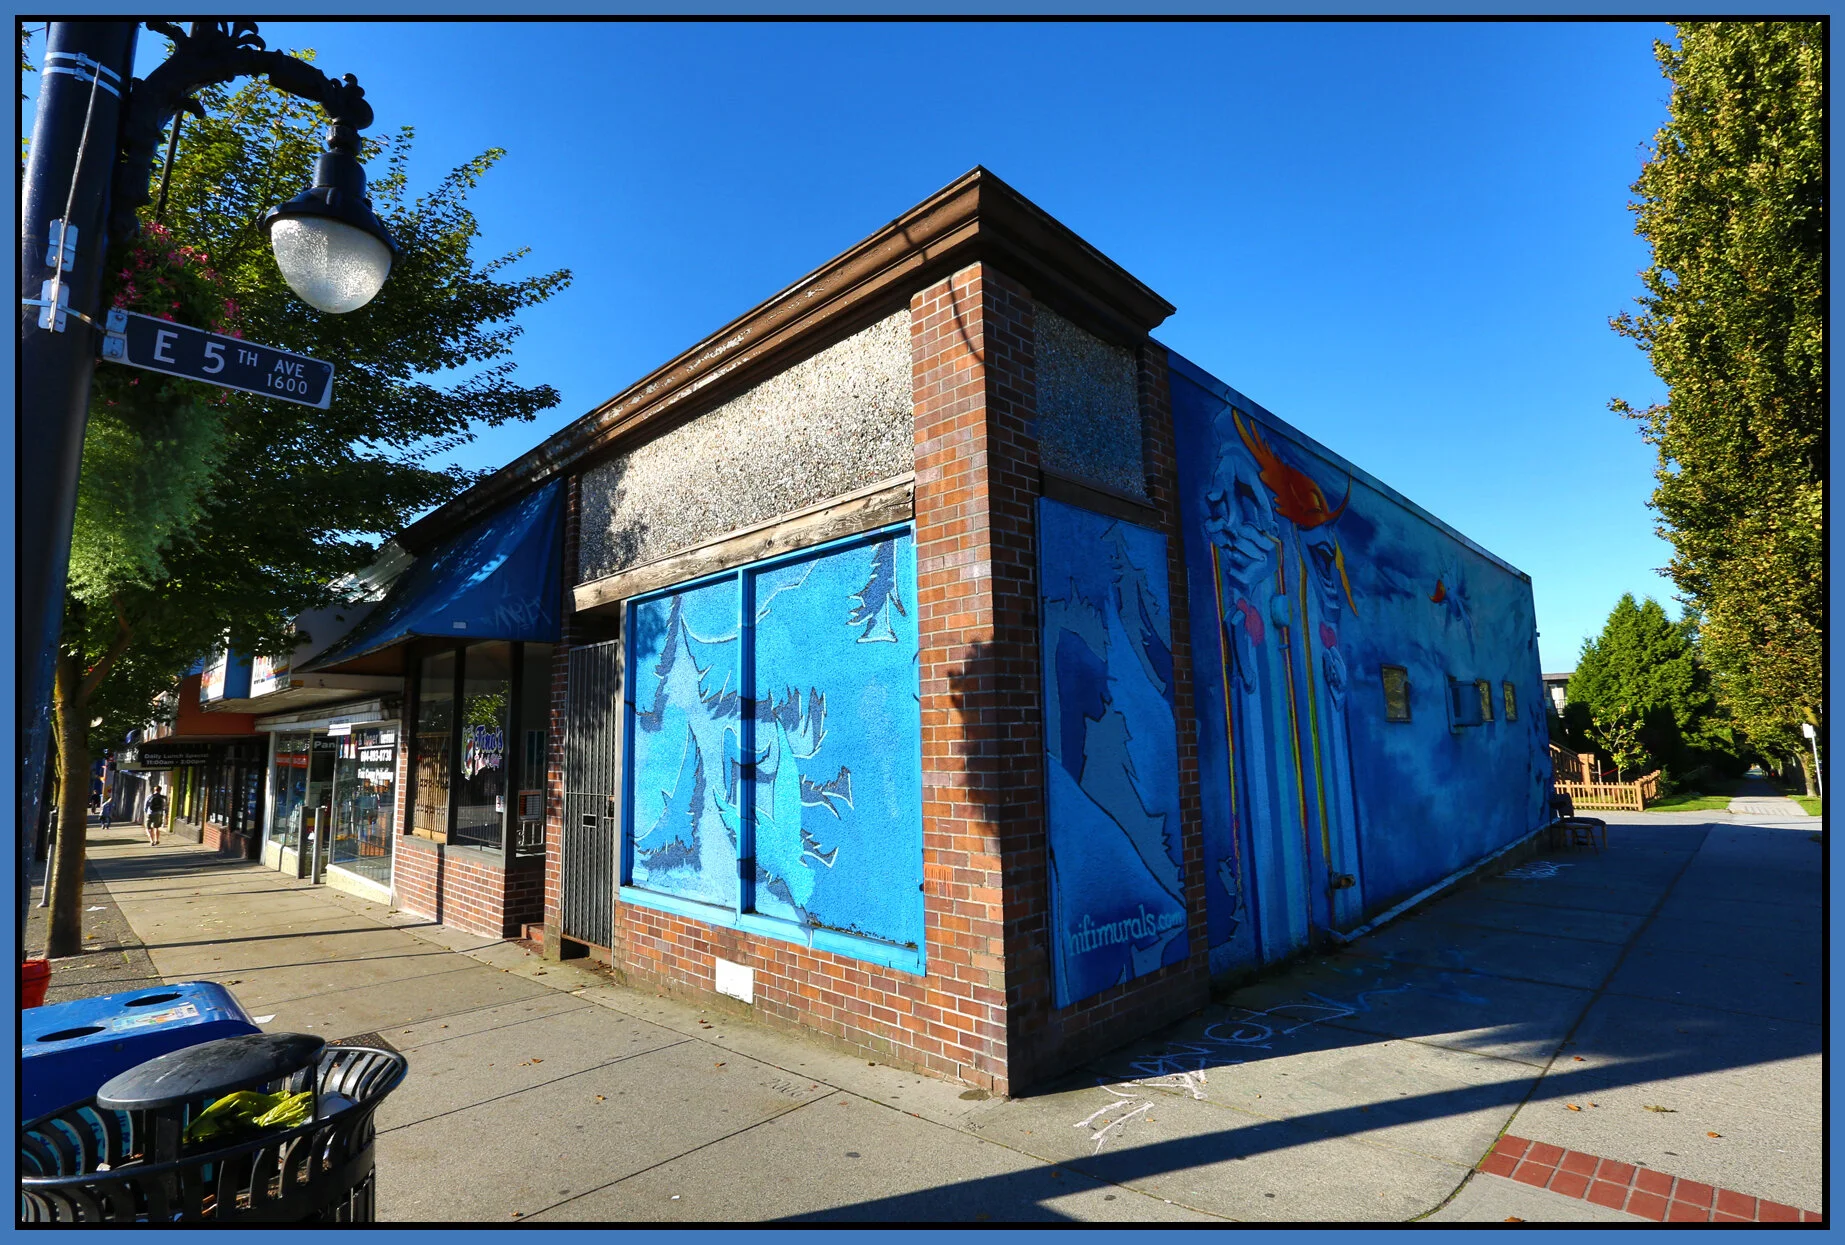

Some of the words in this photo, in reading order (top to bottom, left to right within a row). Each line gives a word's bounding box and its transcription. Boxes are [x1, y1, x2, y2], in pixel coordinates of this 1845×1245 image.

[154, 329, 179, 364] E
[202, 341, 226, 374] 5
[238, 349, 259, 368] TH
[274, 359, 305, 378] AVE
[267, 374, 307, 395] 1600
[1069, 903, 1182, 956] hifimurals.com
